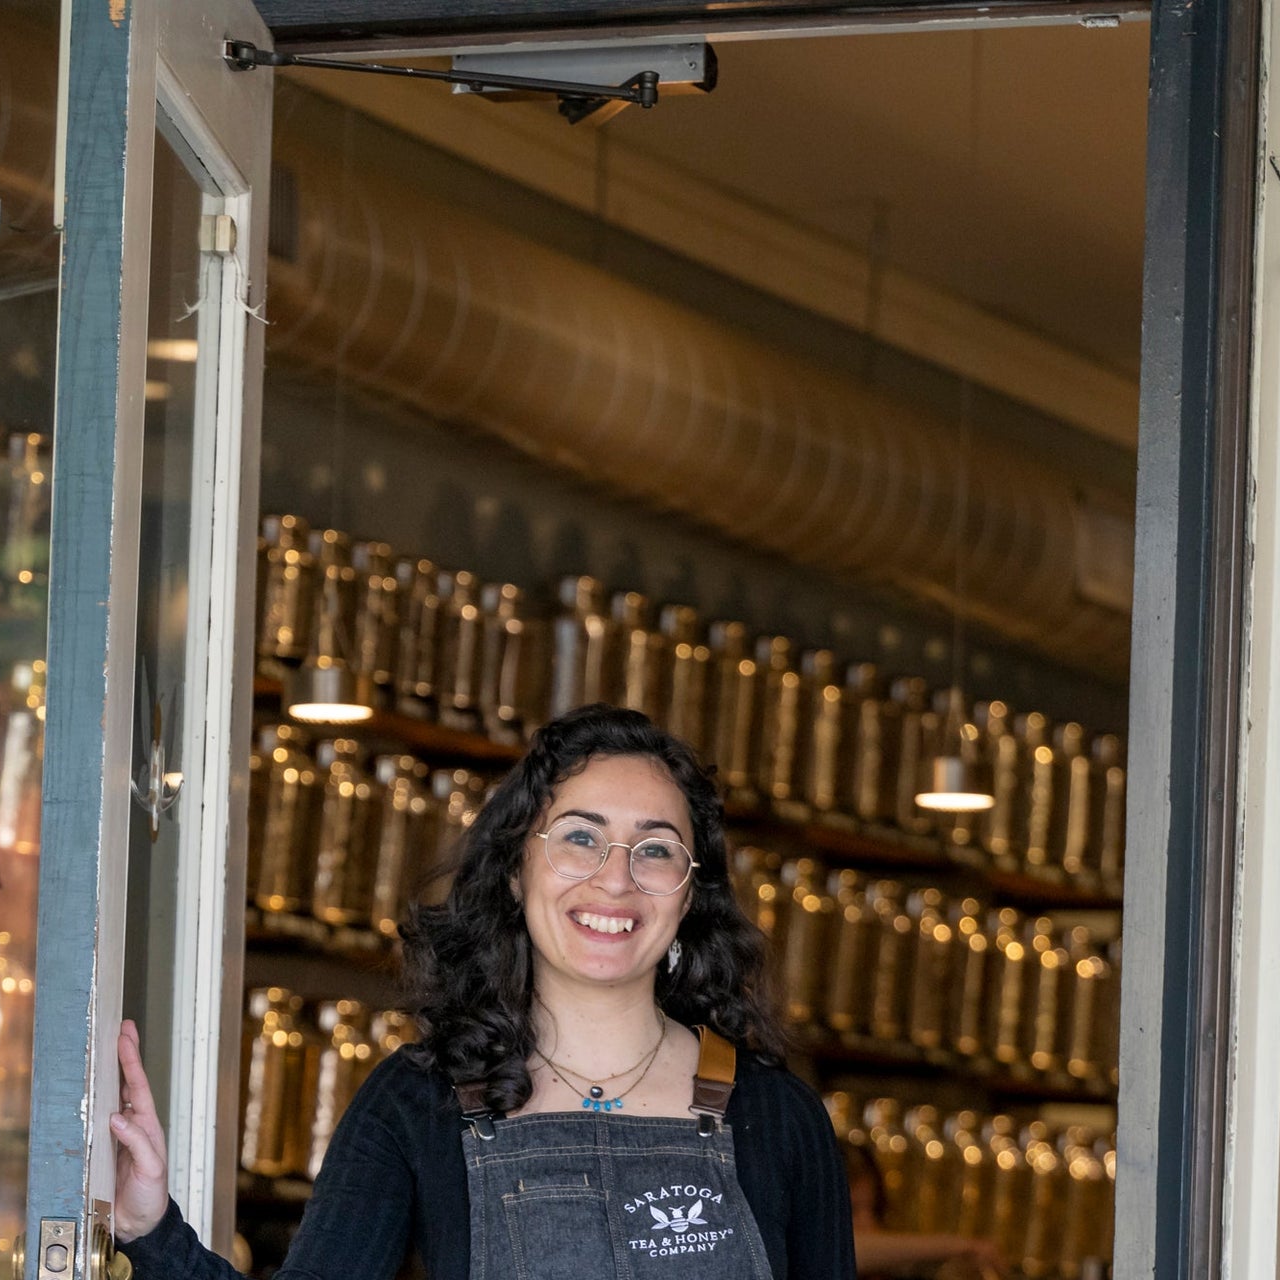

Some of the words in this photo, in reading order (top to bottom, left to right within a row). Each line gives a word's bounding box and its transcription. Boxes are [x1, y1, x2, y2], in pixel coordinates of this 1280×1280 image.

[624, 1185, 722, 1213] SARATOGA
[629, 1239, 657, 1249] TEA
[662, 1238, 671, 1247] &
[650, 1243, 716, 1257] COMPANY
